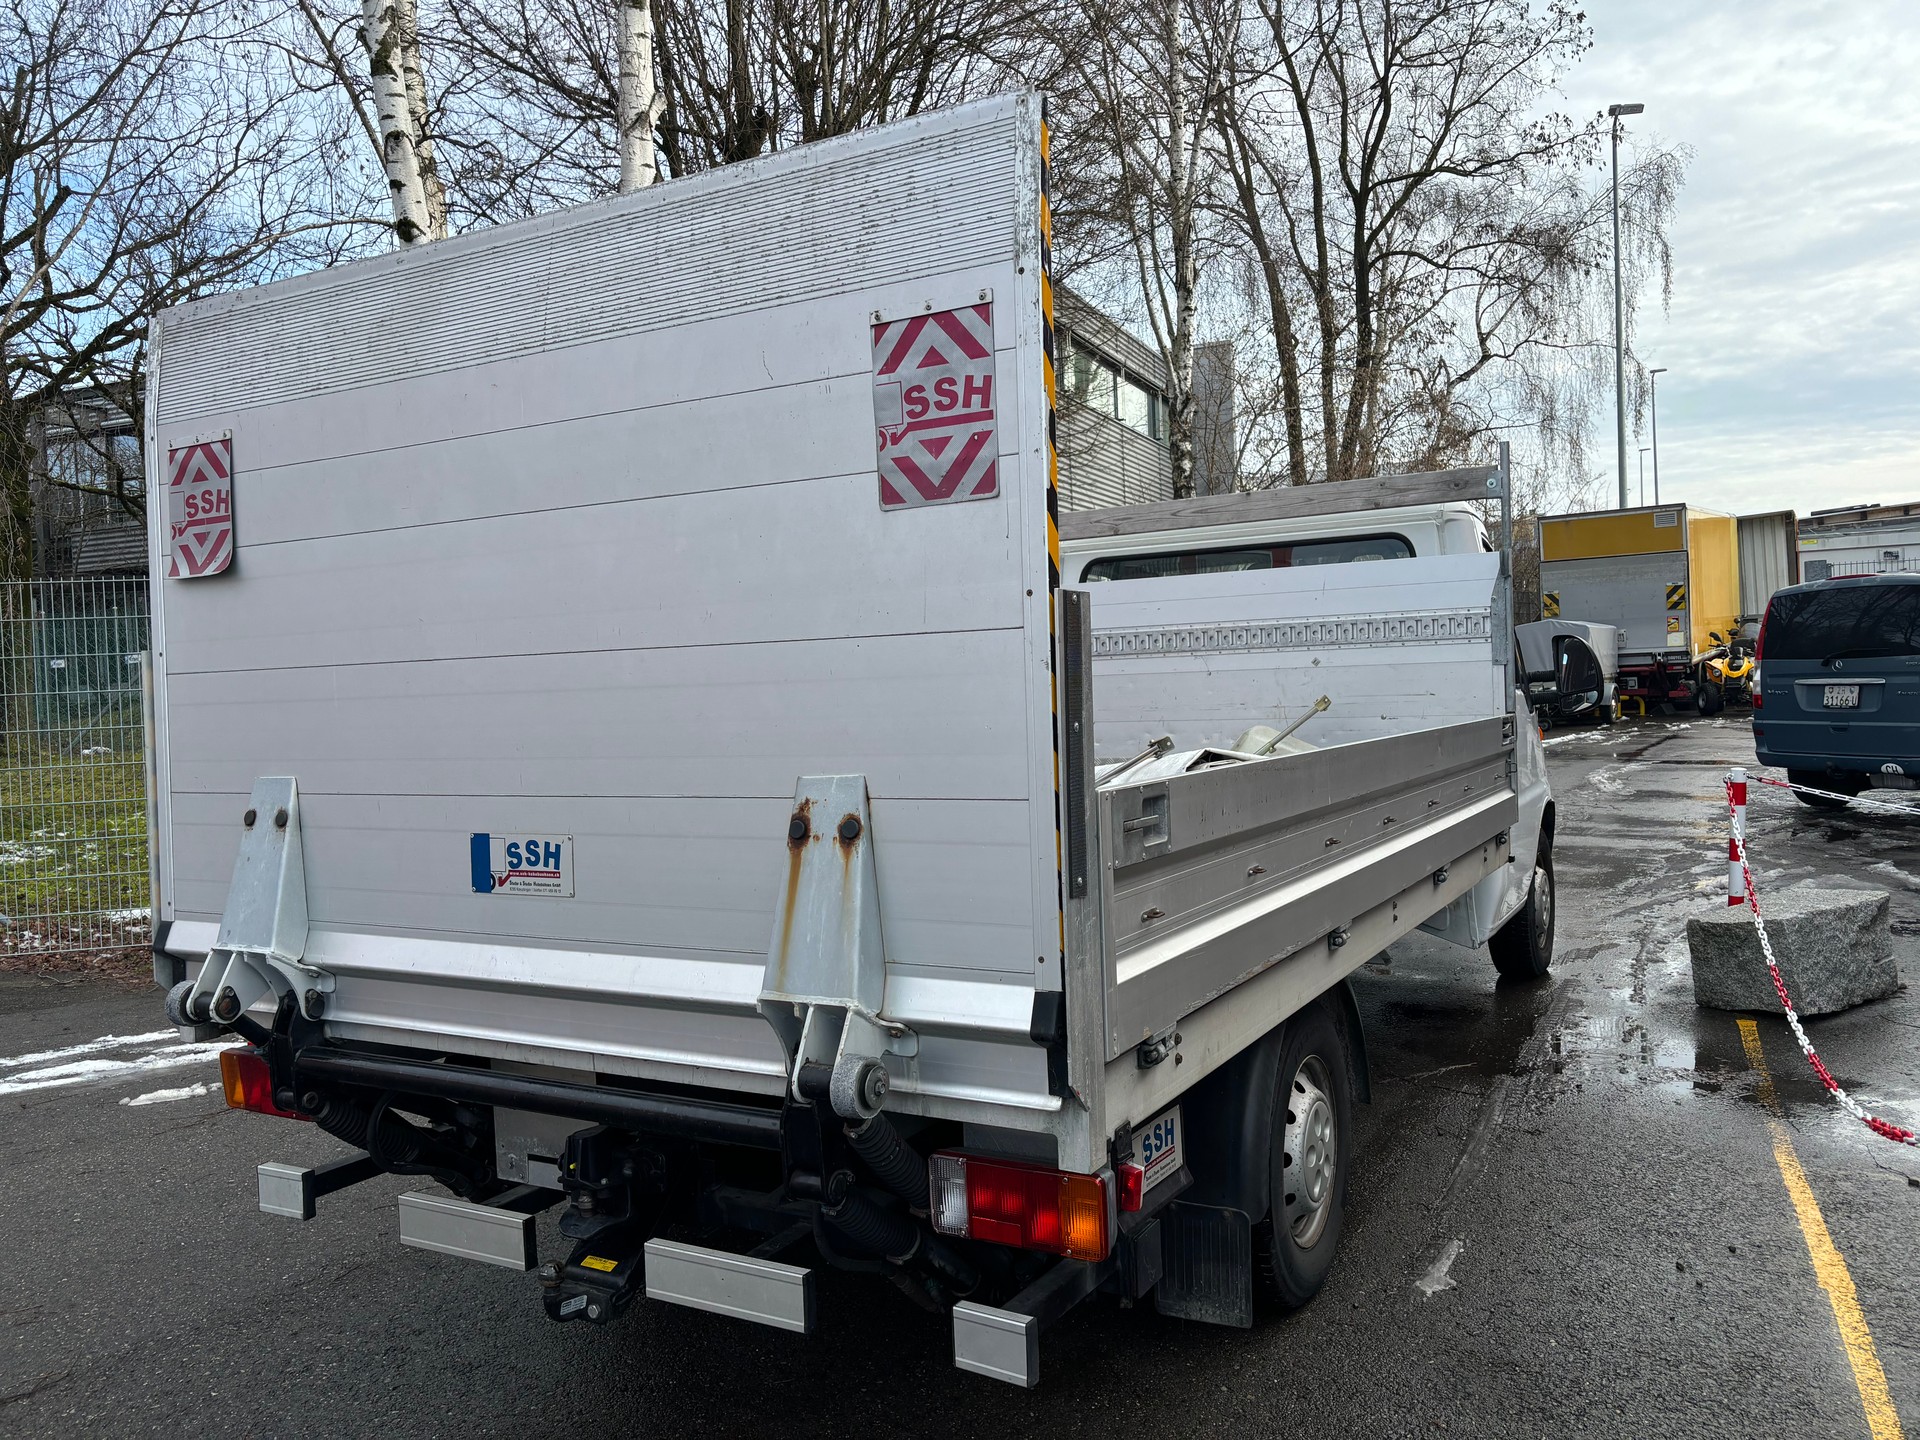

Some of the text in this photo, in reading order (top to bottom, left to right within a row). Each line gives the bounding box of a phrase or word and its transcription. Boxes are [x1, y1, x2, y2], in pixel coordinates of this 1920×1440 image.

[903, 375, 993, 420] SSH
[185, 489, 229, 519] SSH
[1824, 695, 1858, 706] 31166 U
[506, 839, 561, 870] SSH
[1143, 1118, 1175, 1163] SSH
